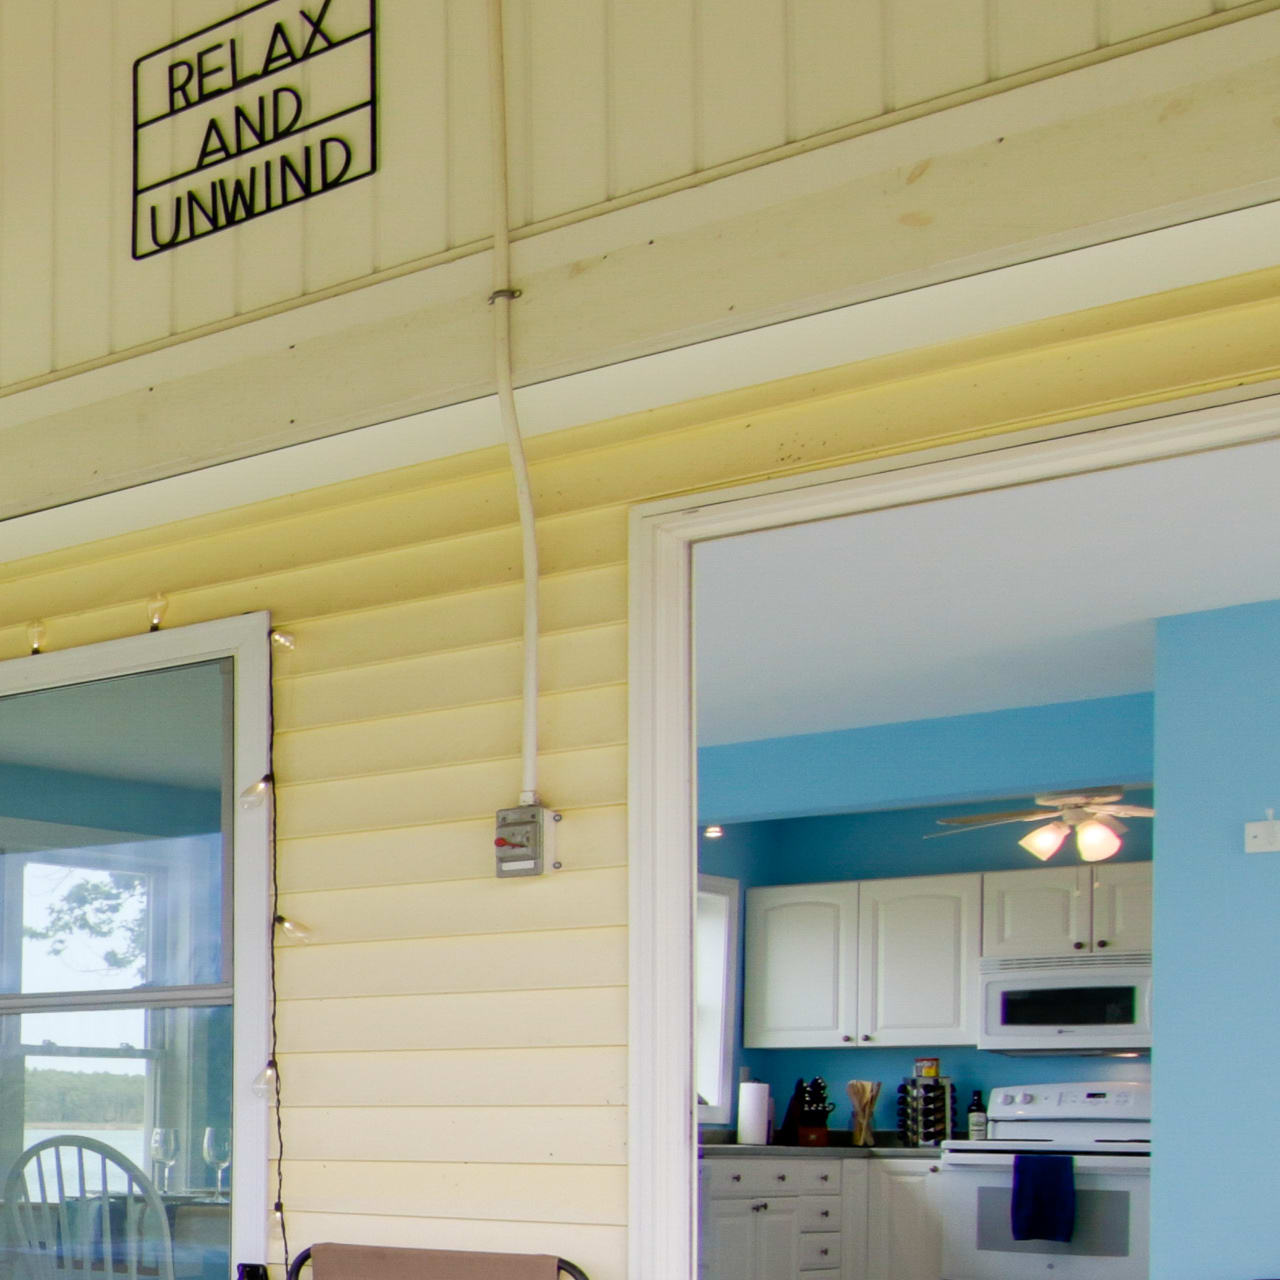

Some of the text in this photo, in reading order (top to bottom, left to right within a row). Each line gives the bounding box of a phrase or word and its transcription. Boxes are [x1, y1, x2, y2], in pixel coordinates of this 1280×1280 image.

[168, 0, 334, 113] RELAX
[197, 87, 302, 170] AND
[150, 137, 352, 249] UNWIND
